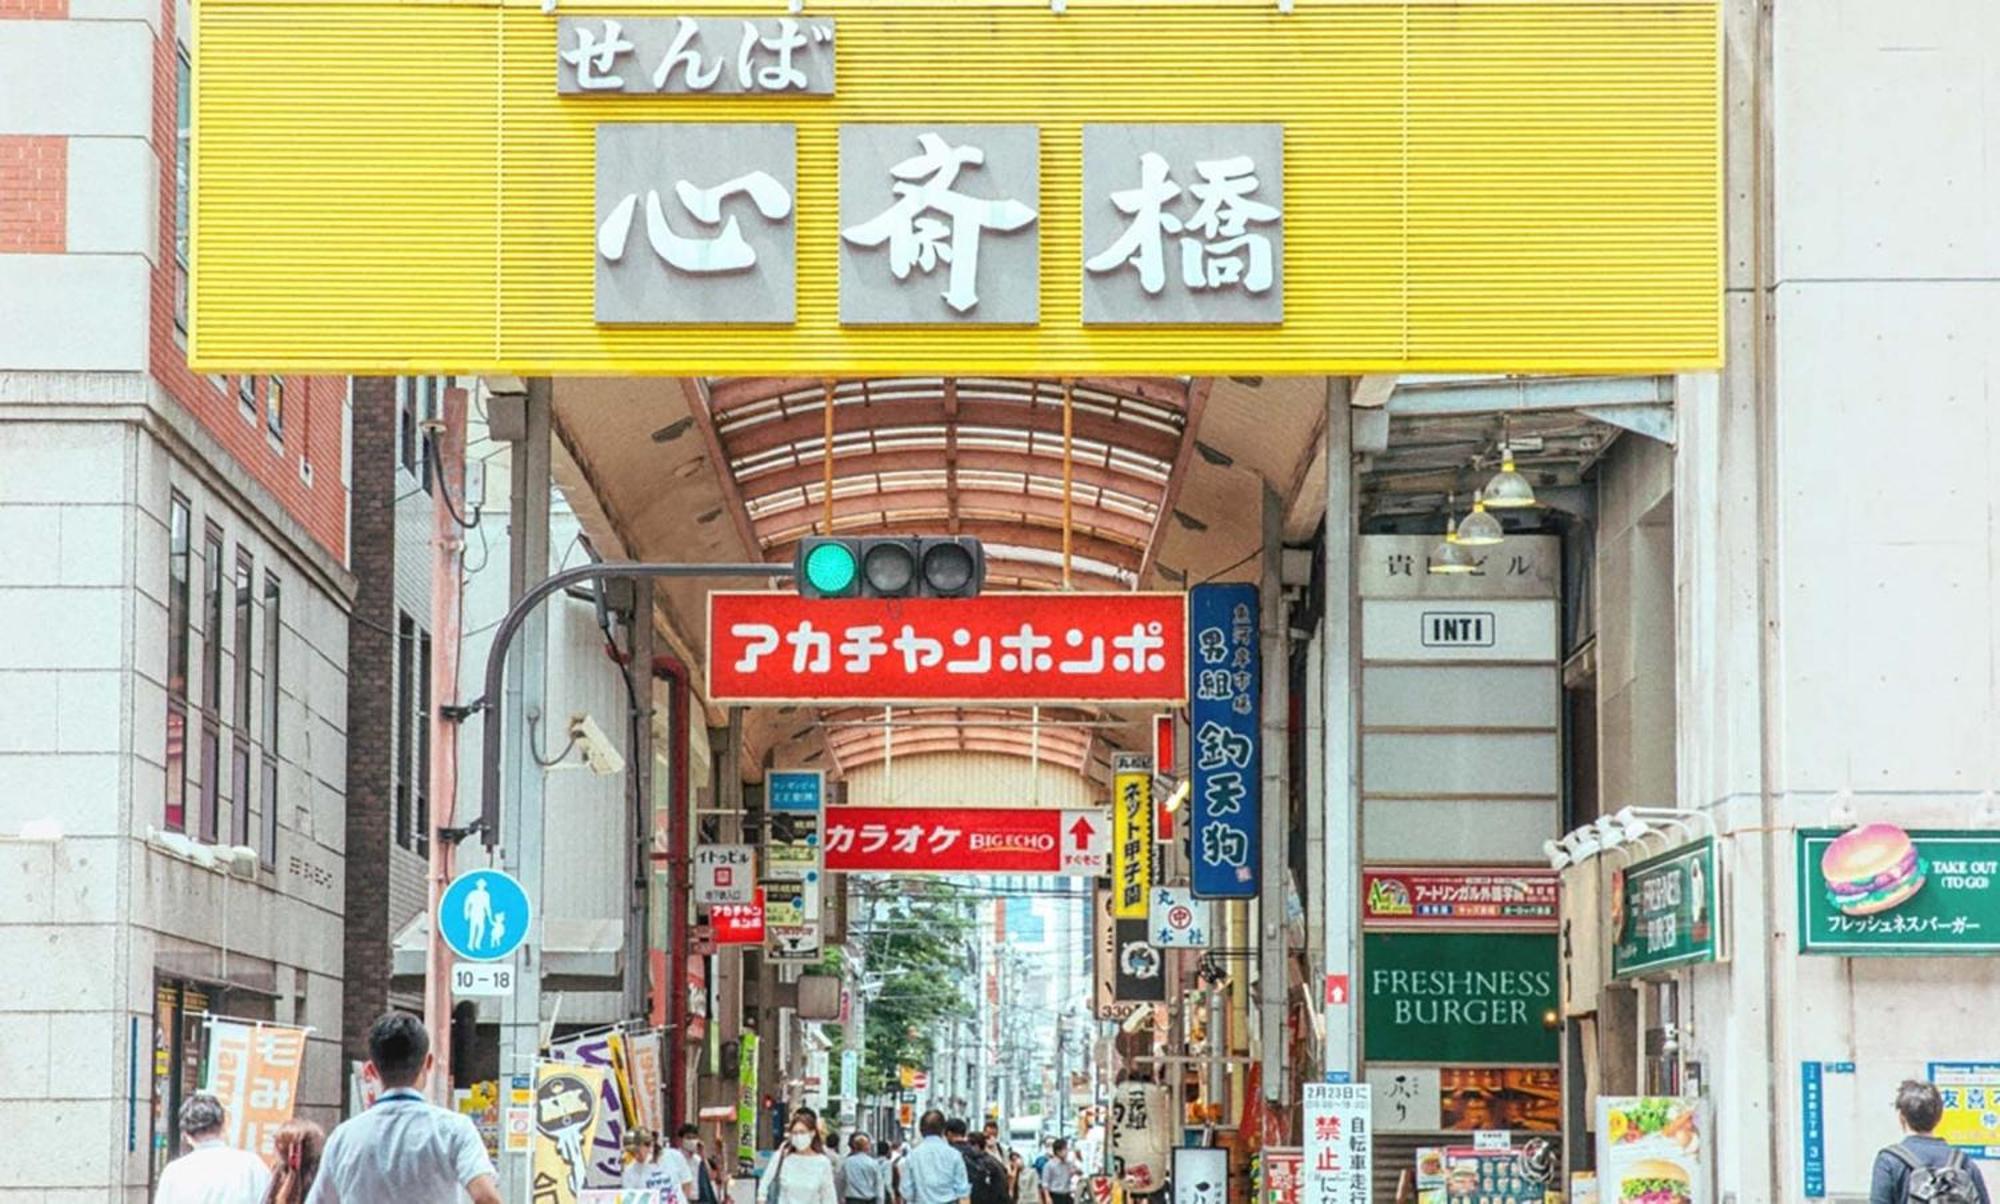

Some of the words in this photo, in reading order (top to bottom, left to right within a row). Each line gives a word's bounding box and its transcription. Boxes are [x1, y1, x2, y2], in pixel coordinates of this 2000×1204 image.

[561, 19, 831, 90] せんば
[598, 132, 1281, 313] 心斎橋
[1433, 618, 1482, 641] INTI
[730, 620, 1166, 674] アカチャンホンポ
[824, 823, 962, 854] カラオケ
[969, 833, 1004, 850] BIG
[1005, 833, 1055, 850] ECHO
[1123, 782, 1142, 909] ネット甲子園
[1932, 860, 1968, 875] TAKE
[1970, 860, 1998, 875] OUT
[1171, 908, 1189, 927] 中
[1827, 915, 1981, 935] フレッシュネスバーガー
[1372, 969, 1551, 997] FRESHNESS
[1395, 999, 1529, 1025] BURGER
